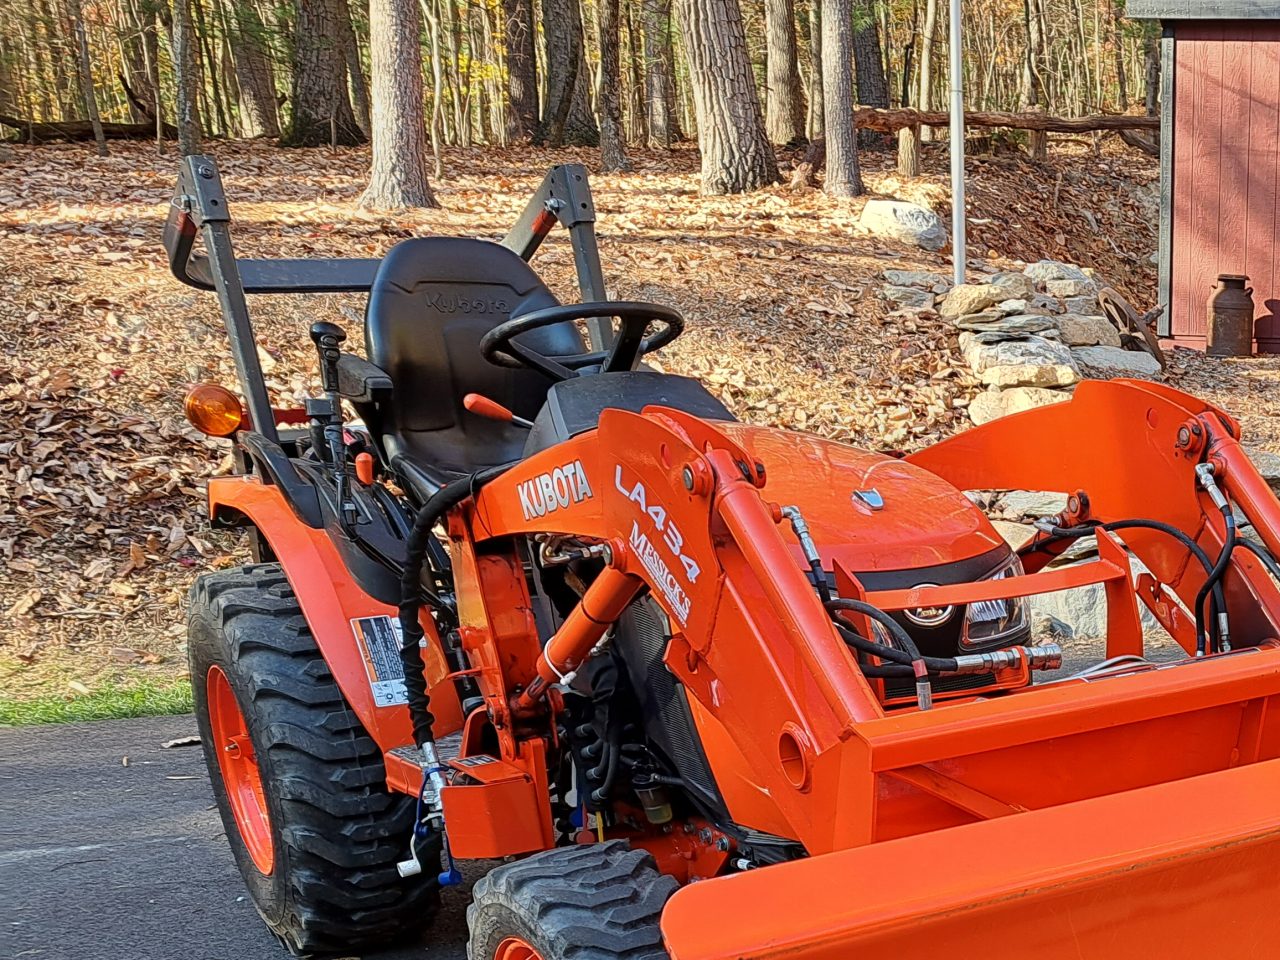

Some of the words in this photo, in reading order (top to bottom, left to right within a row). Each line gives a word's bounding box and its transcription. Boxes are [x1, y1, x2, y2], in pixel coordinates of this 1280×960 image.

[425, 291, 511, 314] Kubota
[516, 460, 593, 521] KUBOTA
[614, 464, 701, 584] LA434
[629, 520, 692, 614] MESSICK'S
